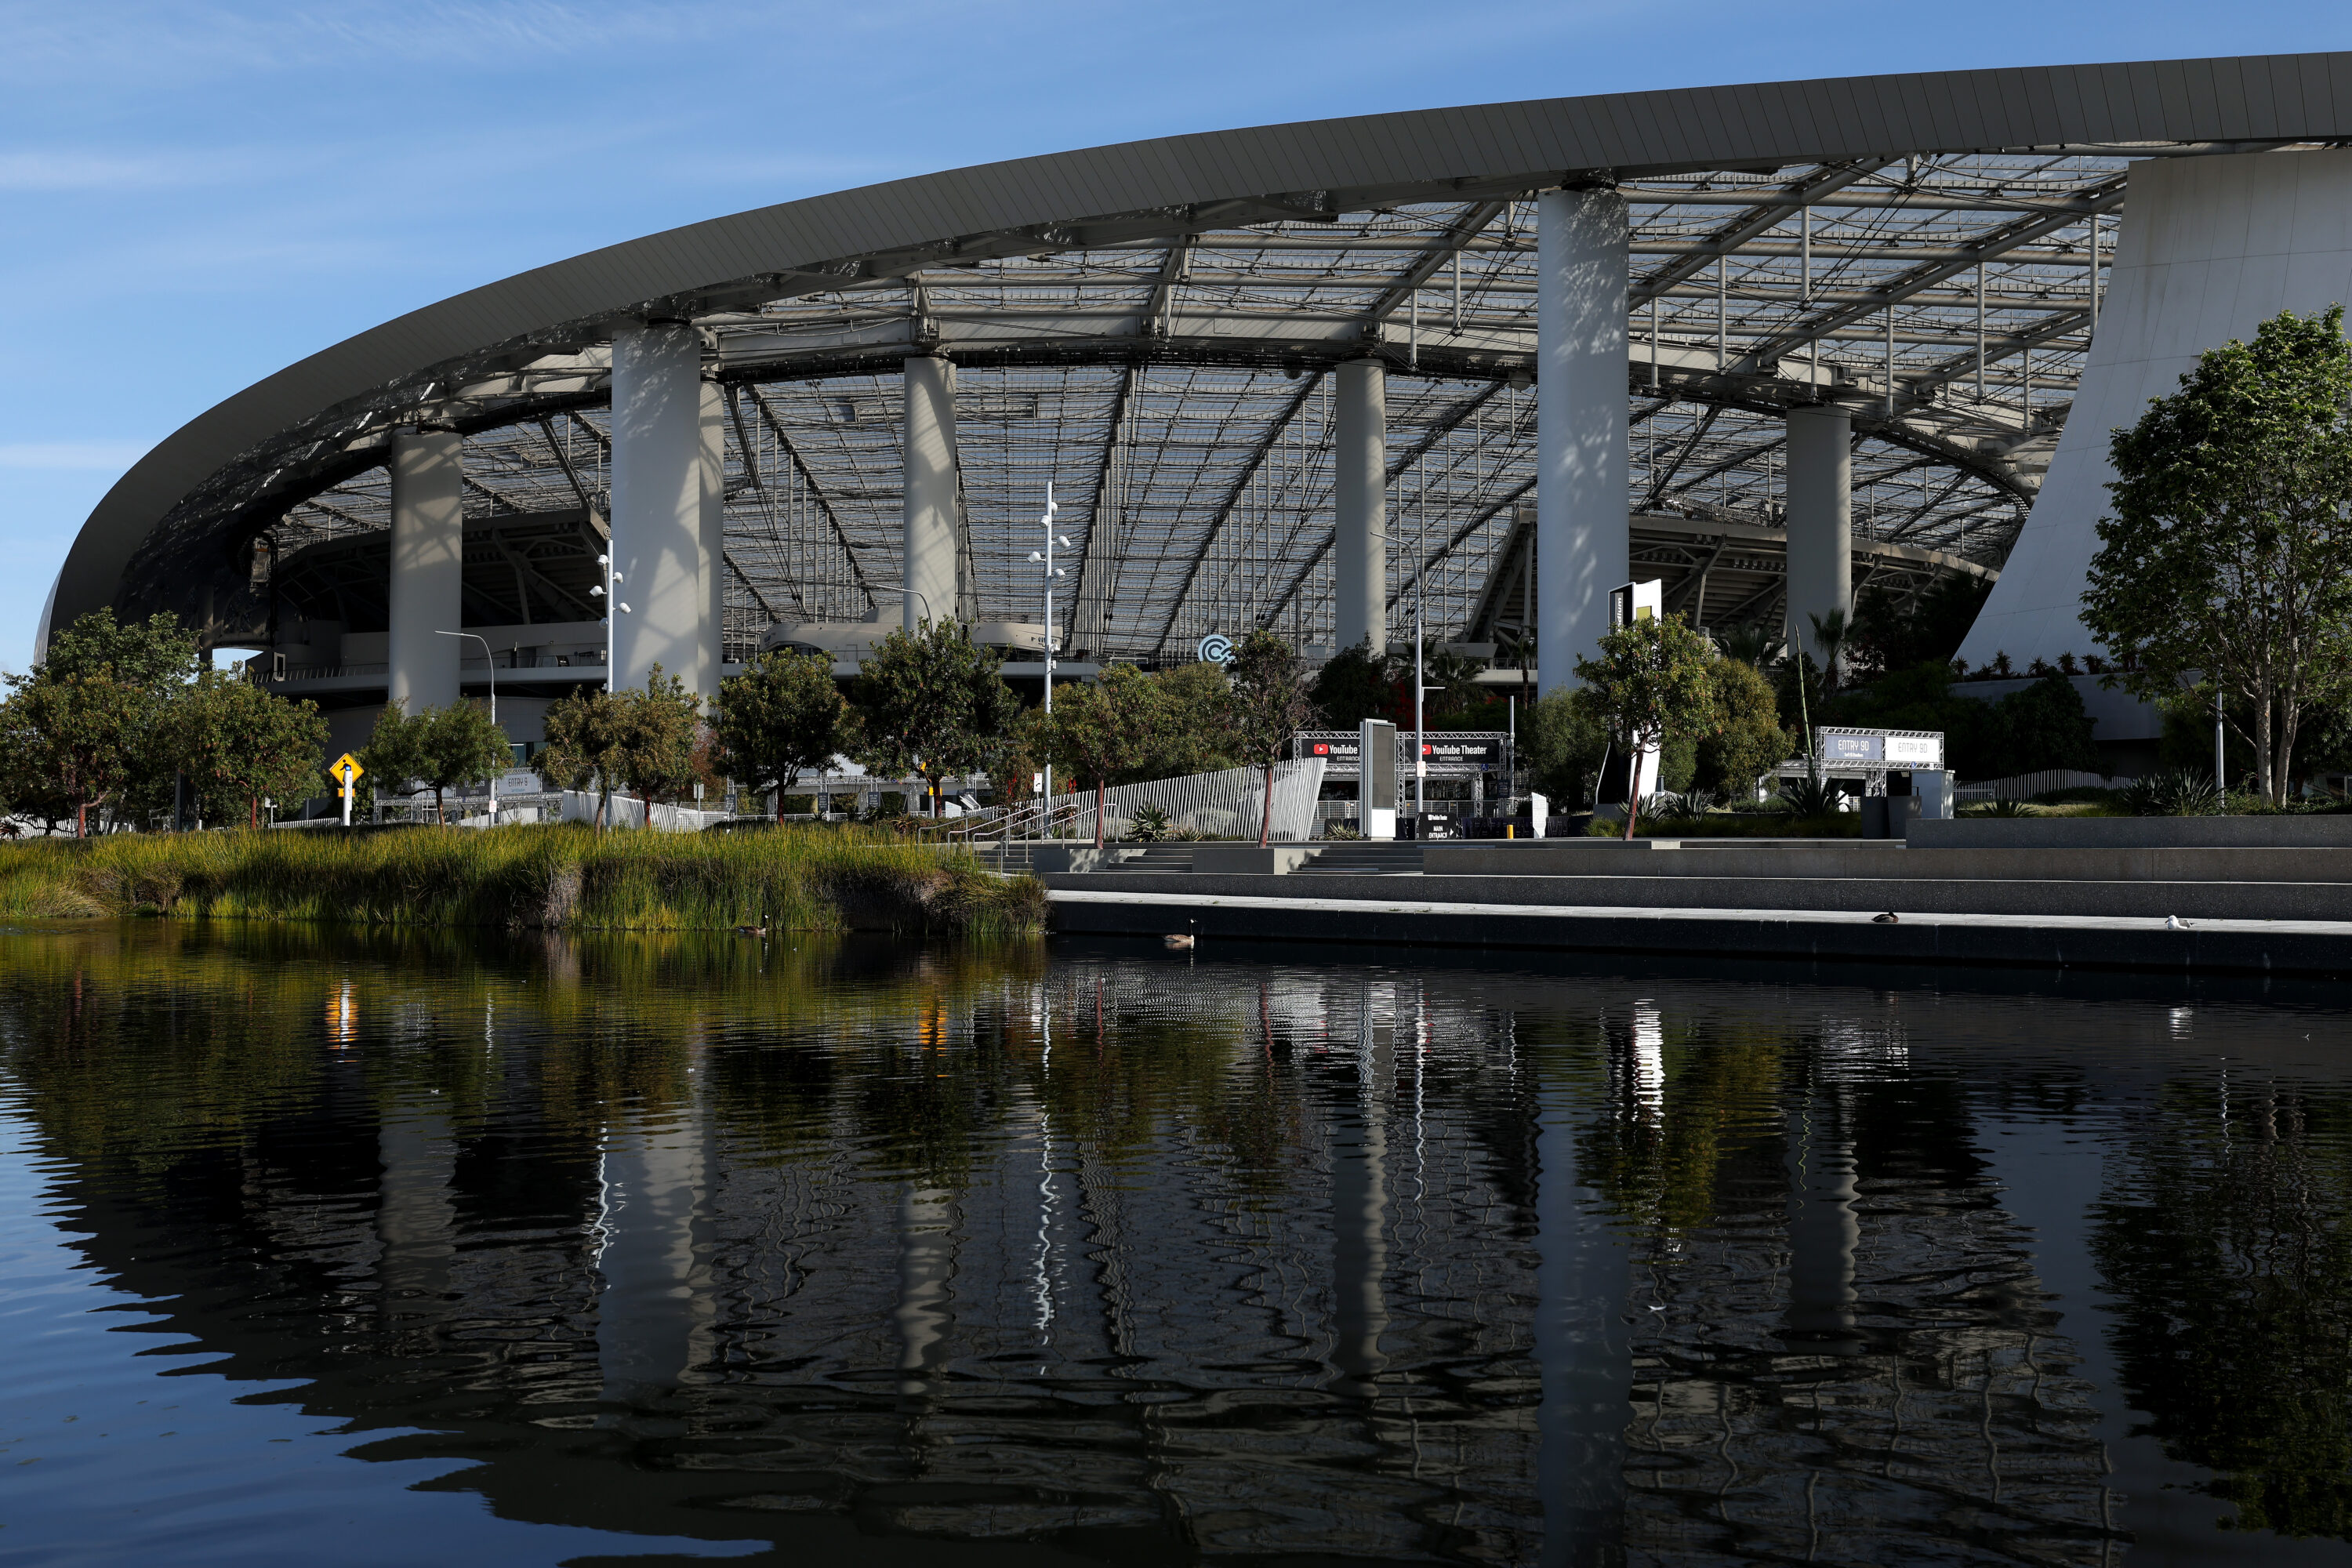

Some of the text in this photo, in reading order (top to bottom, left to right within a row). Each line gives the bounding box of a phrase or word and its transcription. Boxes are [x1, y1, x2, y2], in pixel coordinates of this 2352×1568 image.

[1329, 744, 1358, 754] YouTube
[1432, 745, 1487, 755] YouTube Theater
[1838, 739, 1869, 751] ENTRY 9D
[1898, 742, 1918, 753] ENTRY
[508, 778, 524, 787] ENTRY
